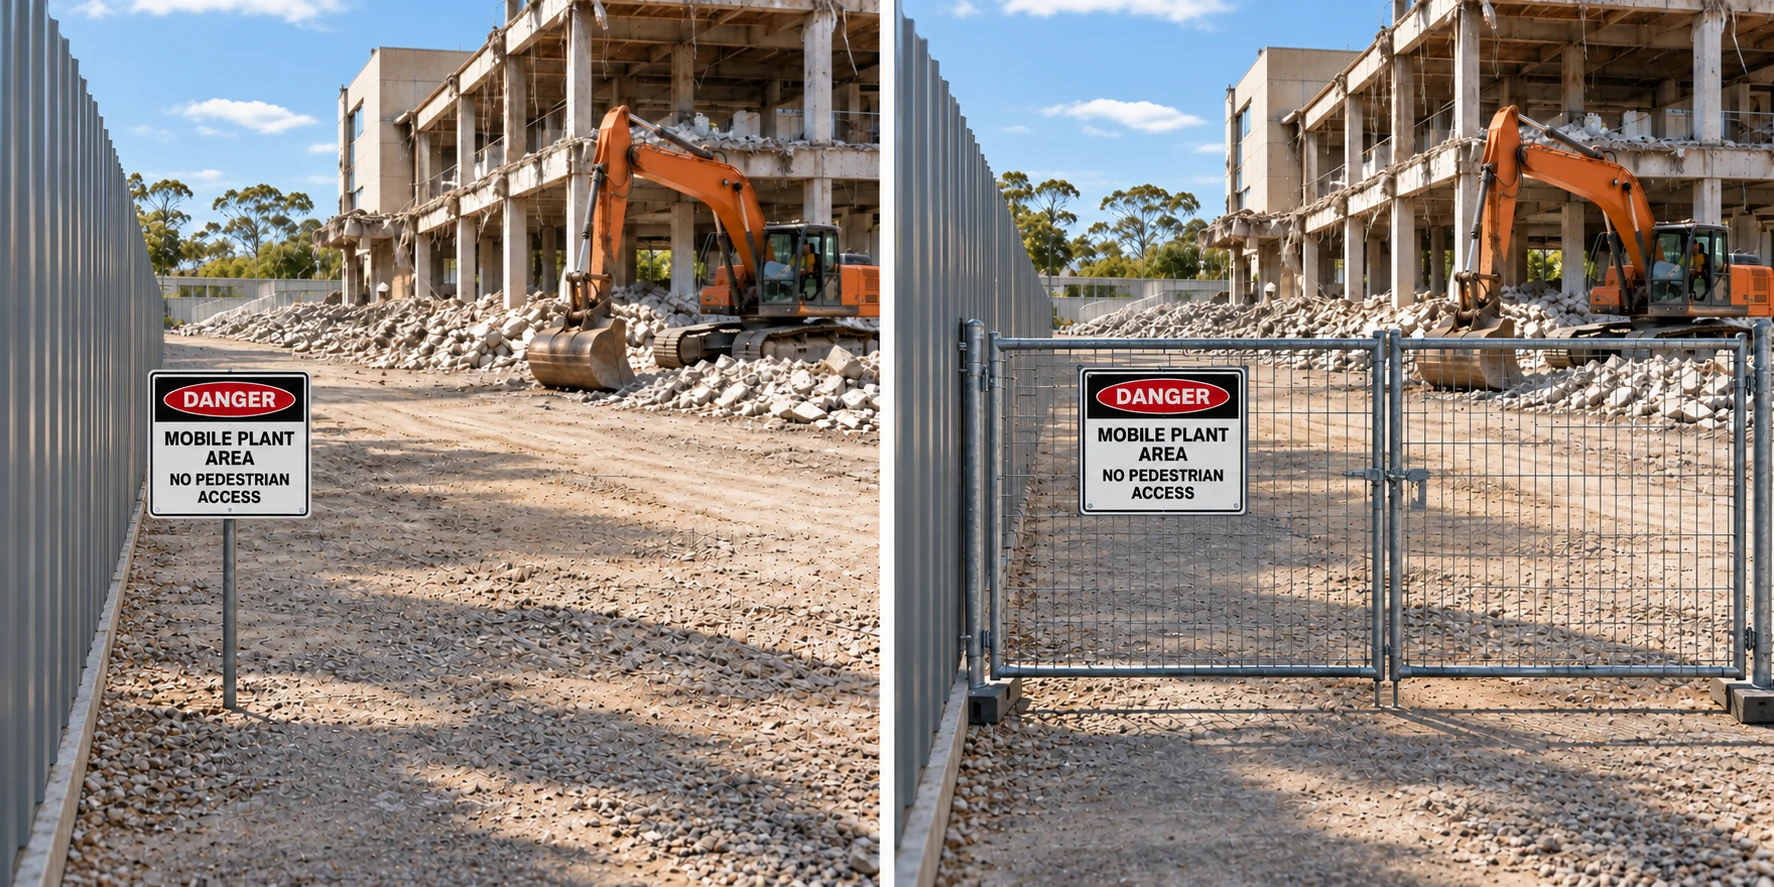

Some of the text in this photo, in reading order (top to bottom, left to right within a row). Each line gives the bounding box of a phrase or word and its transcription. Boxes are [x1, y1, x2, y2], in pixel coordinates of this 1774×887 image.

[183, 391, 276, 408] DANGER
[1116, 388, 1210, 405] DANGER
[165, 431, 295, 446] MOBILE PLANT
[1098, 427, 1229, 442] MOBILE PLANT
[205, 450, 255, 465] AREA
[1139, 446, 1188, 461] AREA
[170, 473, 289, 486] NO PEDESTRIAN
[1103, 469, 1223, 482] NO PEDESTRIAN
[197, 490, 261, 504] ACCESS
[1131, 486, 1195, 500] ACCESS
